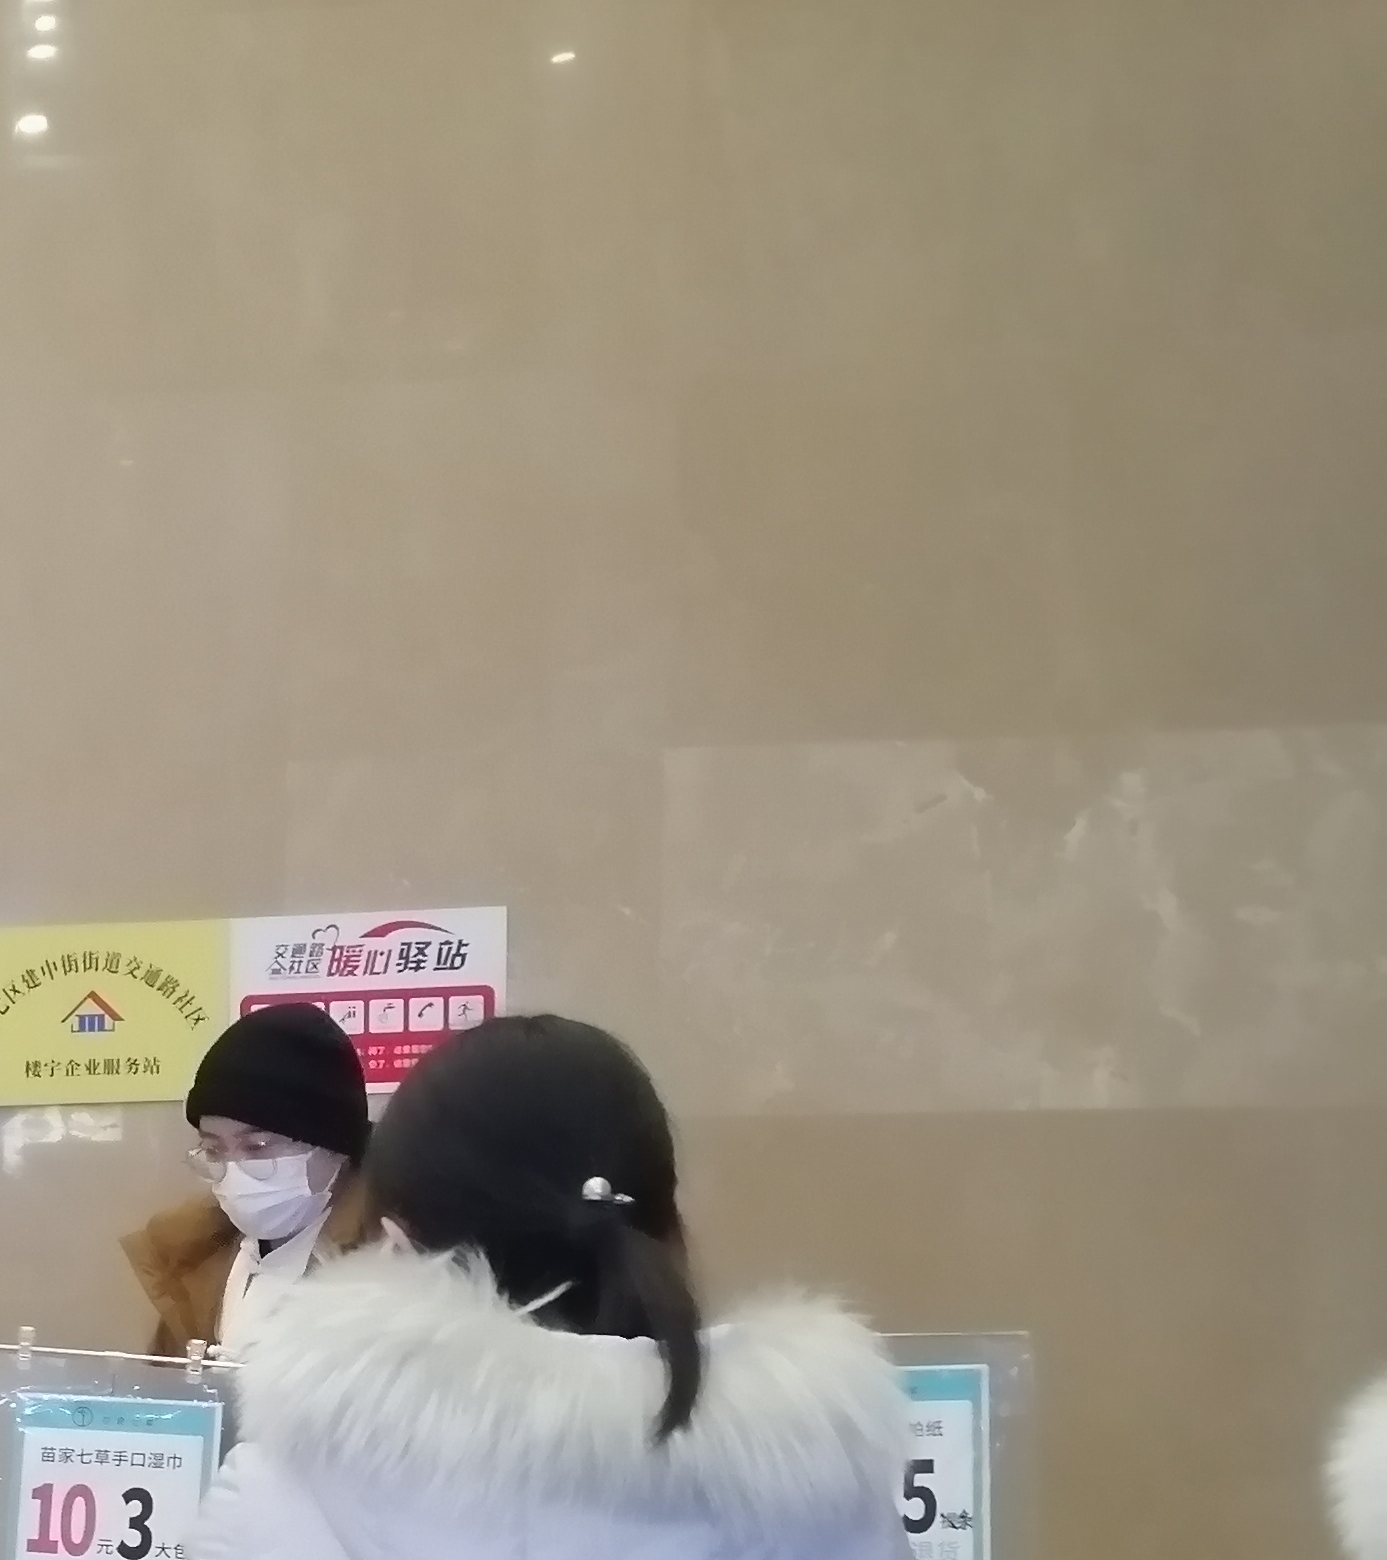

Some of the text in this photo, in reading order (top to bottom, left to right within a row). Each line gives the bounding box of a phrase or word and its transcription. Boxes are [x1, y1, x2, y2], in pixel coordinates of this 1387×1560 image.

[327, 939, 470, 977] 暖心驿站
[40, 1446, 183, 1470] 苗家七草手口湿巾
